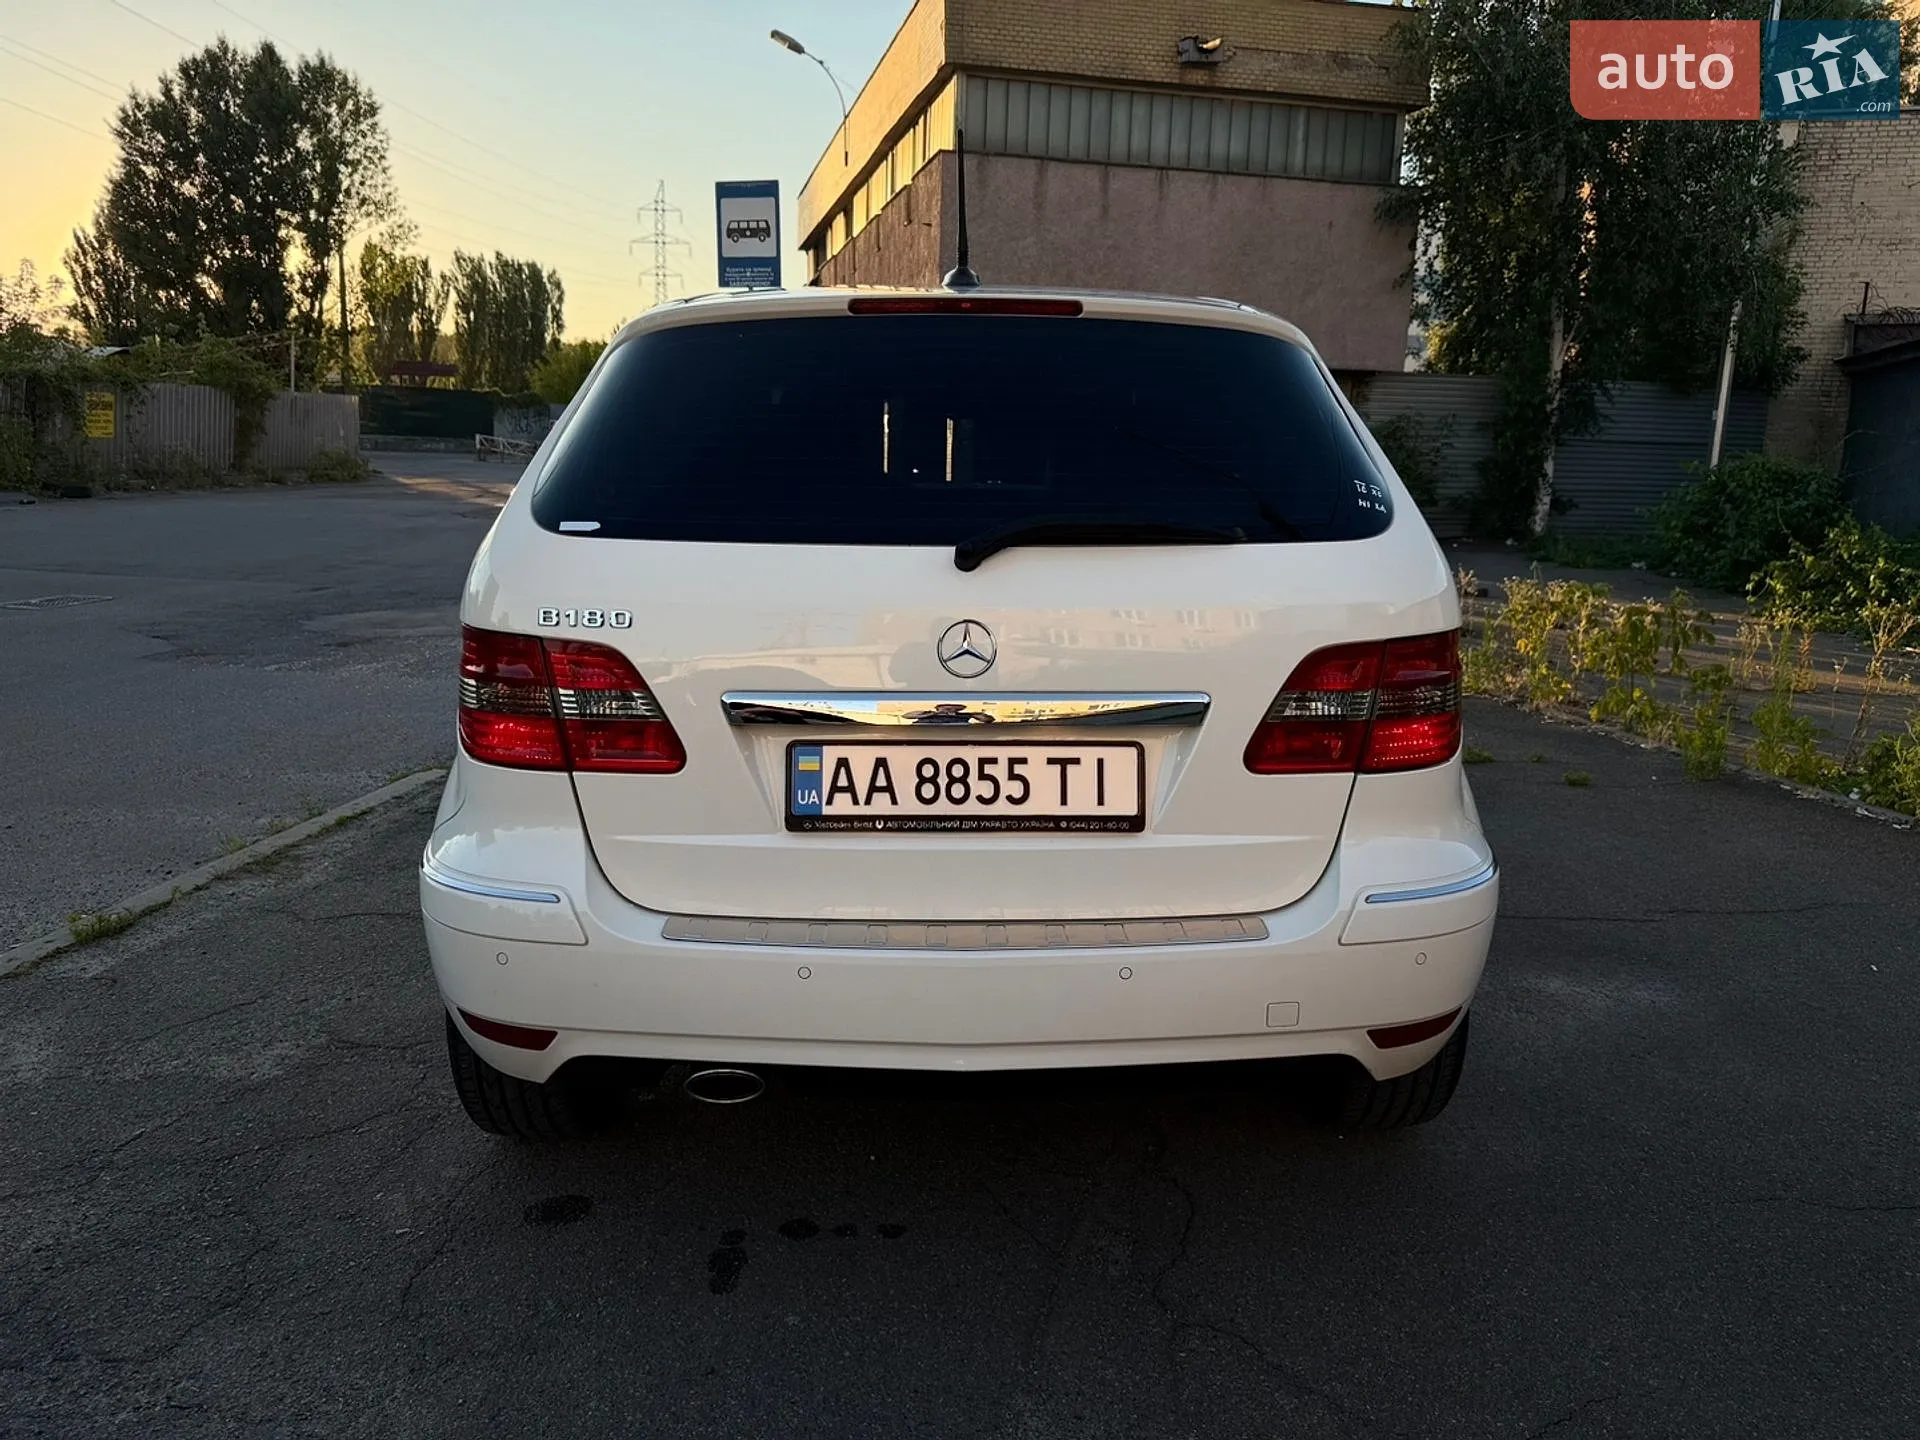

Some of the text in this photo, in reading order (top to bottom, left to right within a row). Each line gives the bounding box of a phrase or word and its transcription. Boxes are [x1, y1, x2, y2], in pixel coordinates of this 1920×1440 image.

[538, 607, 633, 629] B180
[798, 757, 1105, 806] UA AA 8855 TI
